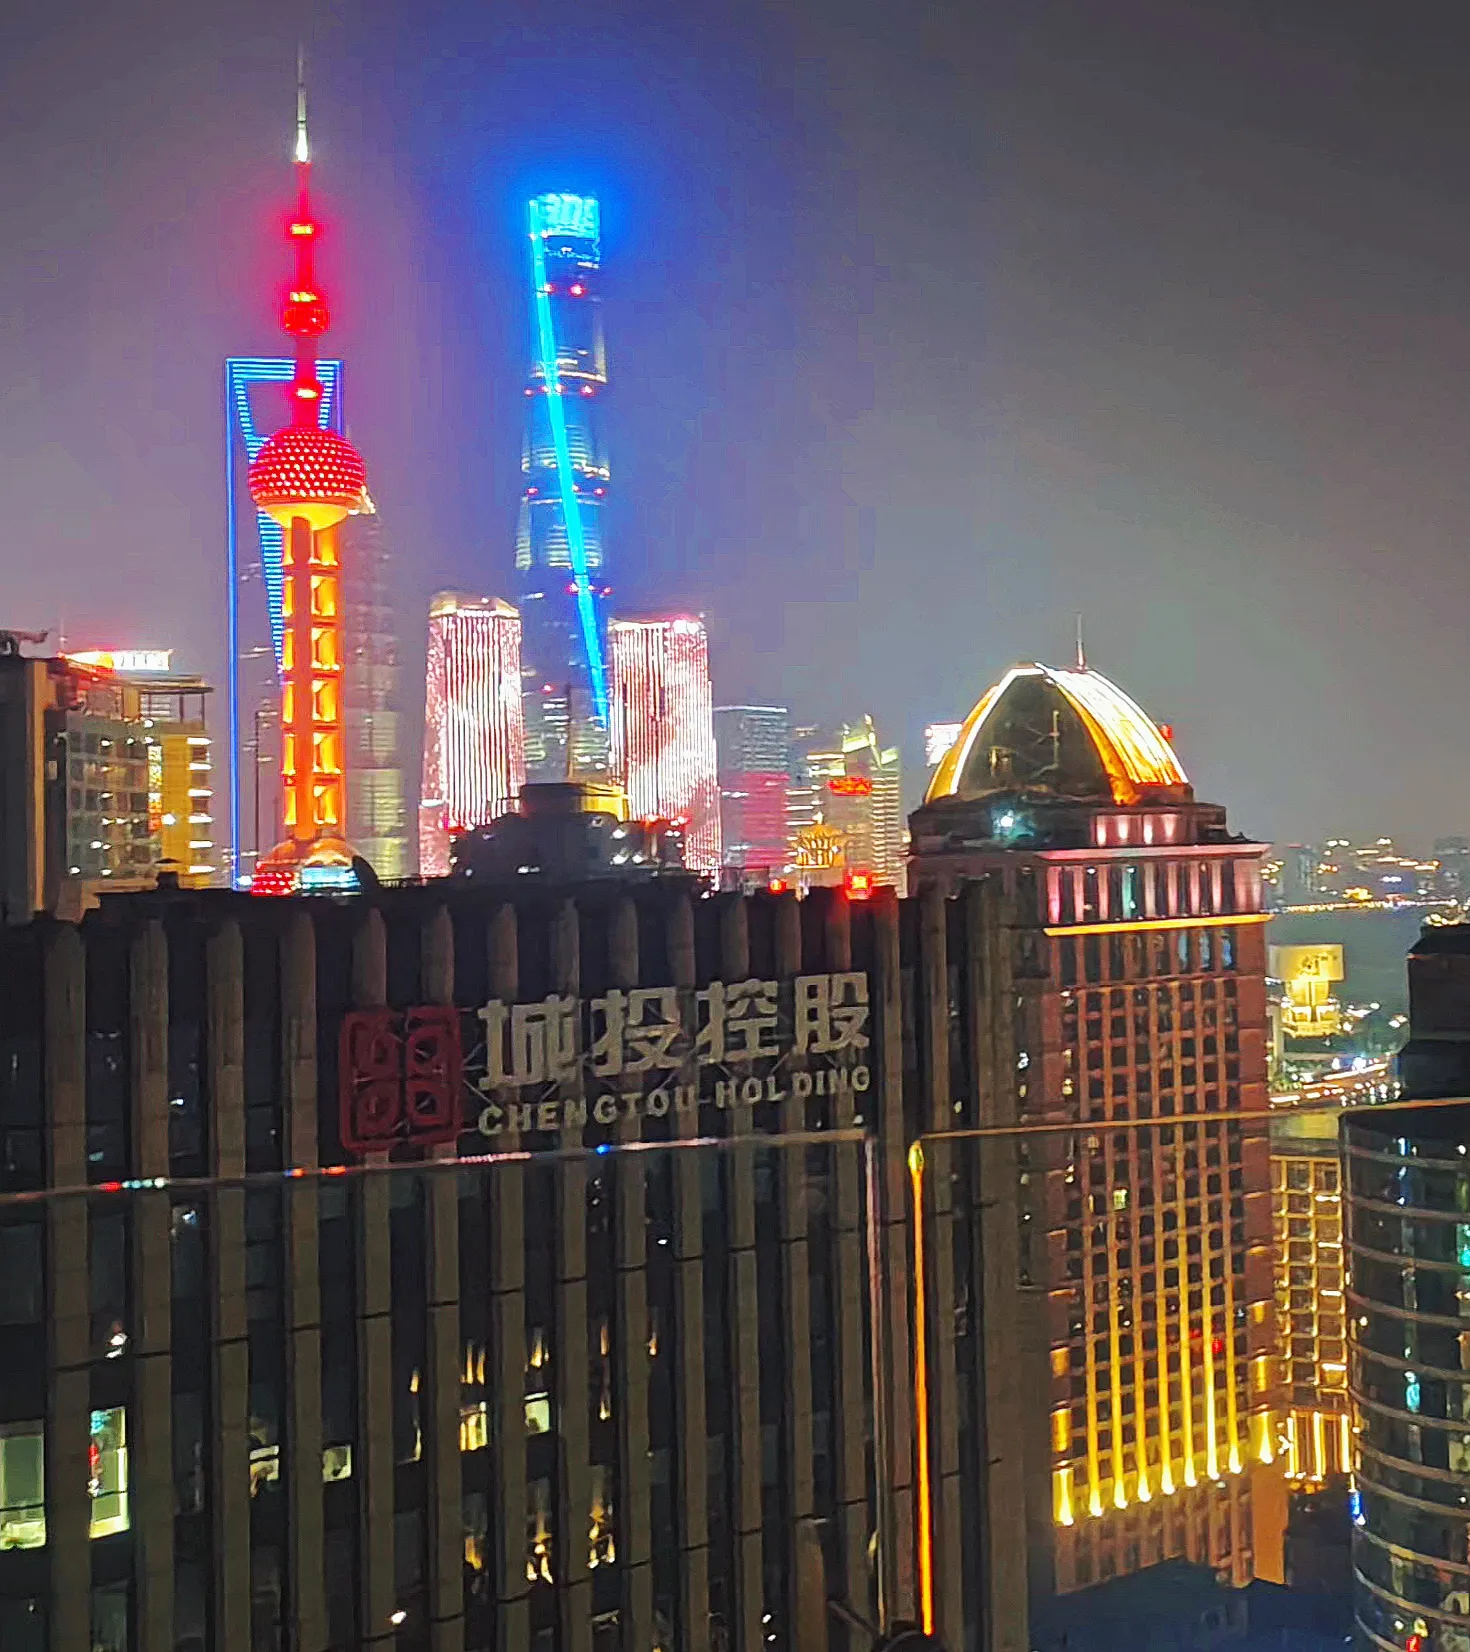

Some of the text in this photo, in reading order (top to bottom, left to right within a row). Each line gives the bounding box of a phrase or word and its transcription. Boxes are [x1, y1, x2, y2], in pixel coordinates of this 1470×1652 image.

[477, 971, 869, 1089] 城投控股
[478, 1065, 871, 1135] CHENGTOU HOLDING
